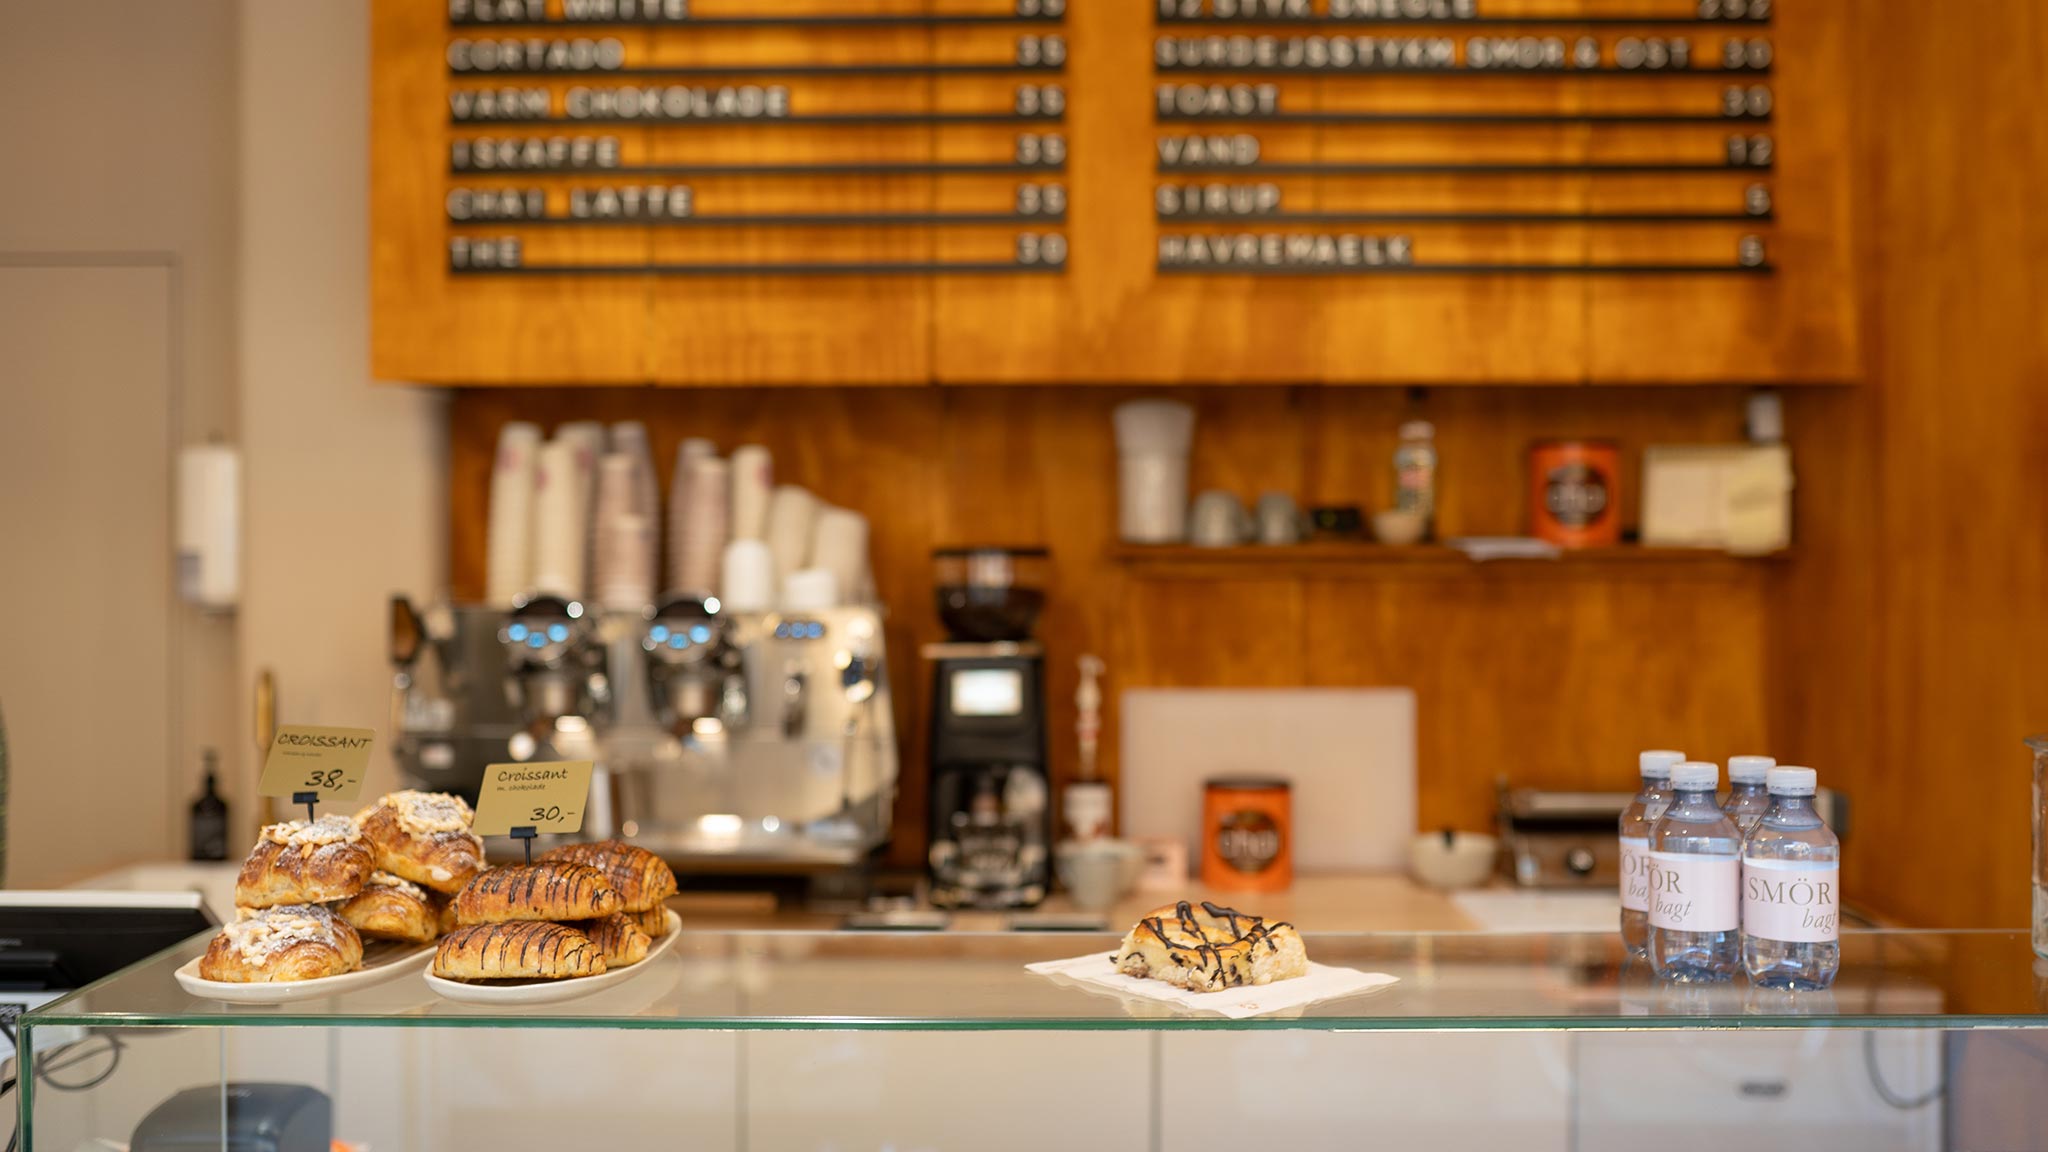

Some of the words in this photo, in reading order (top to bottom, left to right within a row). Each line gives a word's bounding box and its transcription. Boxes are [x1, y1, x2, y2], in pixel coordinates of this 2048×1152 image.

[565, 0, 688, 20] WHITE
[448, 37, 625, 70] CORTADO
[1016, 35, 1066, 64] 35
[1614, 36, 1690, 68] OST
[1723, 38, 1772, 69] 30
[449, 87, 551, 119] VARM
[564, 85, 789, 118] CHOKOLADE
[1016, 84, 1066, 115] 35
[1157, 84, 1279, 115] TOAST
[1723, 84, 1772, 116] 30
[452, 136, 620, 169] ISKAFFE
[1016, 133, 1066, 164] 35
[1157, 134, 1261, 165] VAND
[1727, 135, 1772, 165] 12
[447, 188, 545, 219] CHAI
[570, 185, 694, 218] LATTE
[1016, 183, 1066, 214] 35
[1156, 184, 1280, 215] SIRUP
[451, 236, 521, 267] THE
[1016, 233, 1067, 264] 30
[1158, 234, 1412, 265] HAVREMAELK
[277, 733, 374, 749] CROISSANT
[497, 767, 568, 782] Croissant
[1748, 876, 1833, 907] SMÖR
[1655, 893, 1693, 923] bagt
[1802, 907, 1837, 935] bagt
